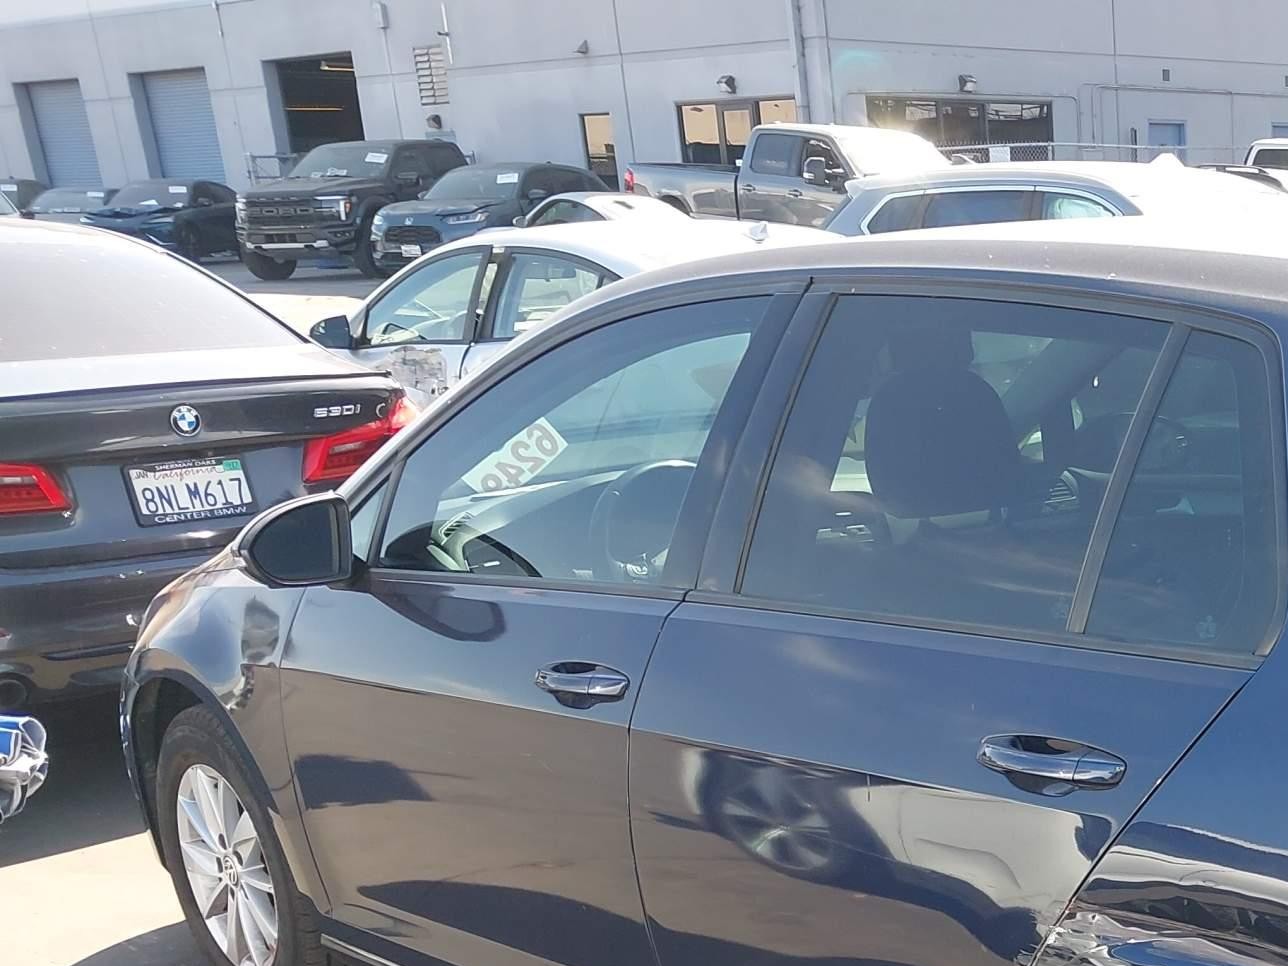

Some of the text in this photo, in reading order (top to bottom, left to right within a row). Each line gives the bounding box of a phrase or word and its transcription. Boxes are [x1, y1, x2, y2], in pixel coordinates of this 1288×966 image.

[141, 477, 245, 514] 8NLM617
[154, 506, 247, 523] CENTER BMW
